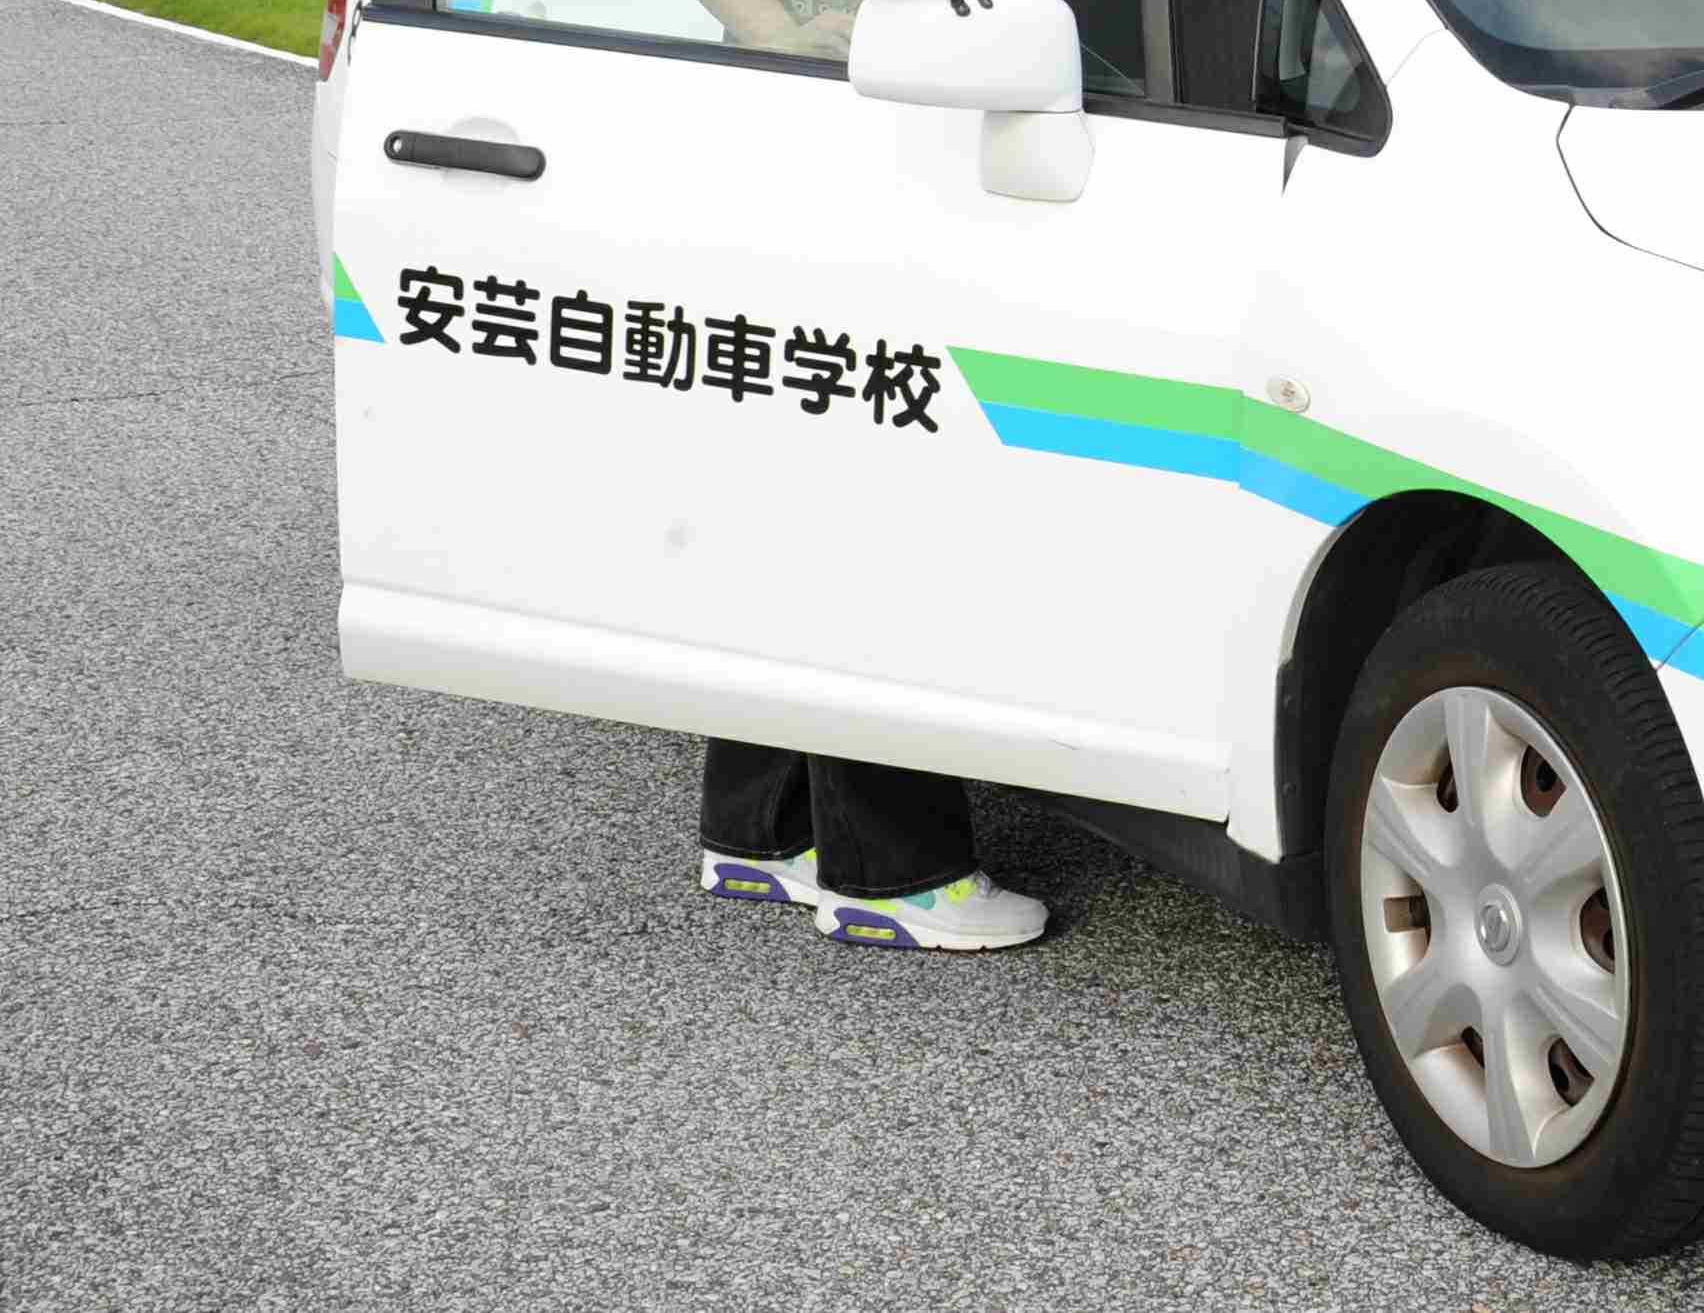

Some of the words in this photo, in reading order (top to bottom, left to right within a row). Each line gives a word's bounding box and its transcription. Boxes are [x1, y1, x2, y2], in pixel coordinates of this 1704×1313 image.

[397, 265, 941, 433] 安芸自動車学校
